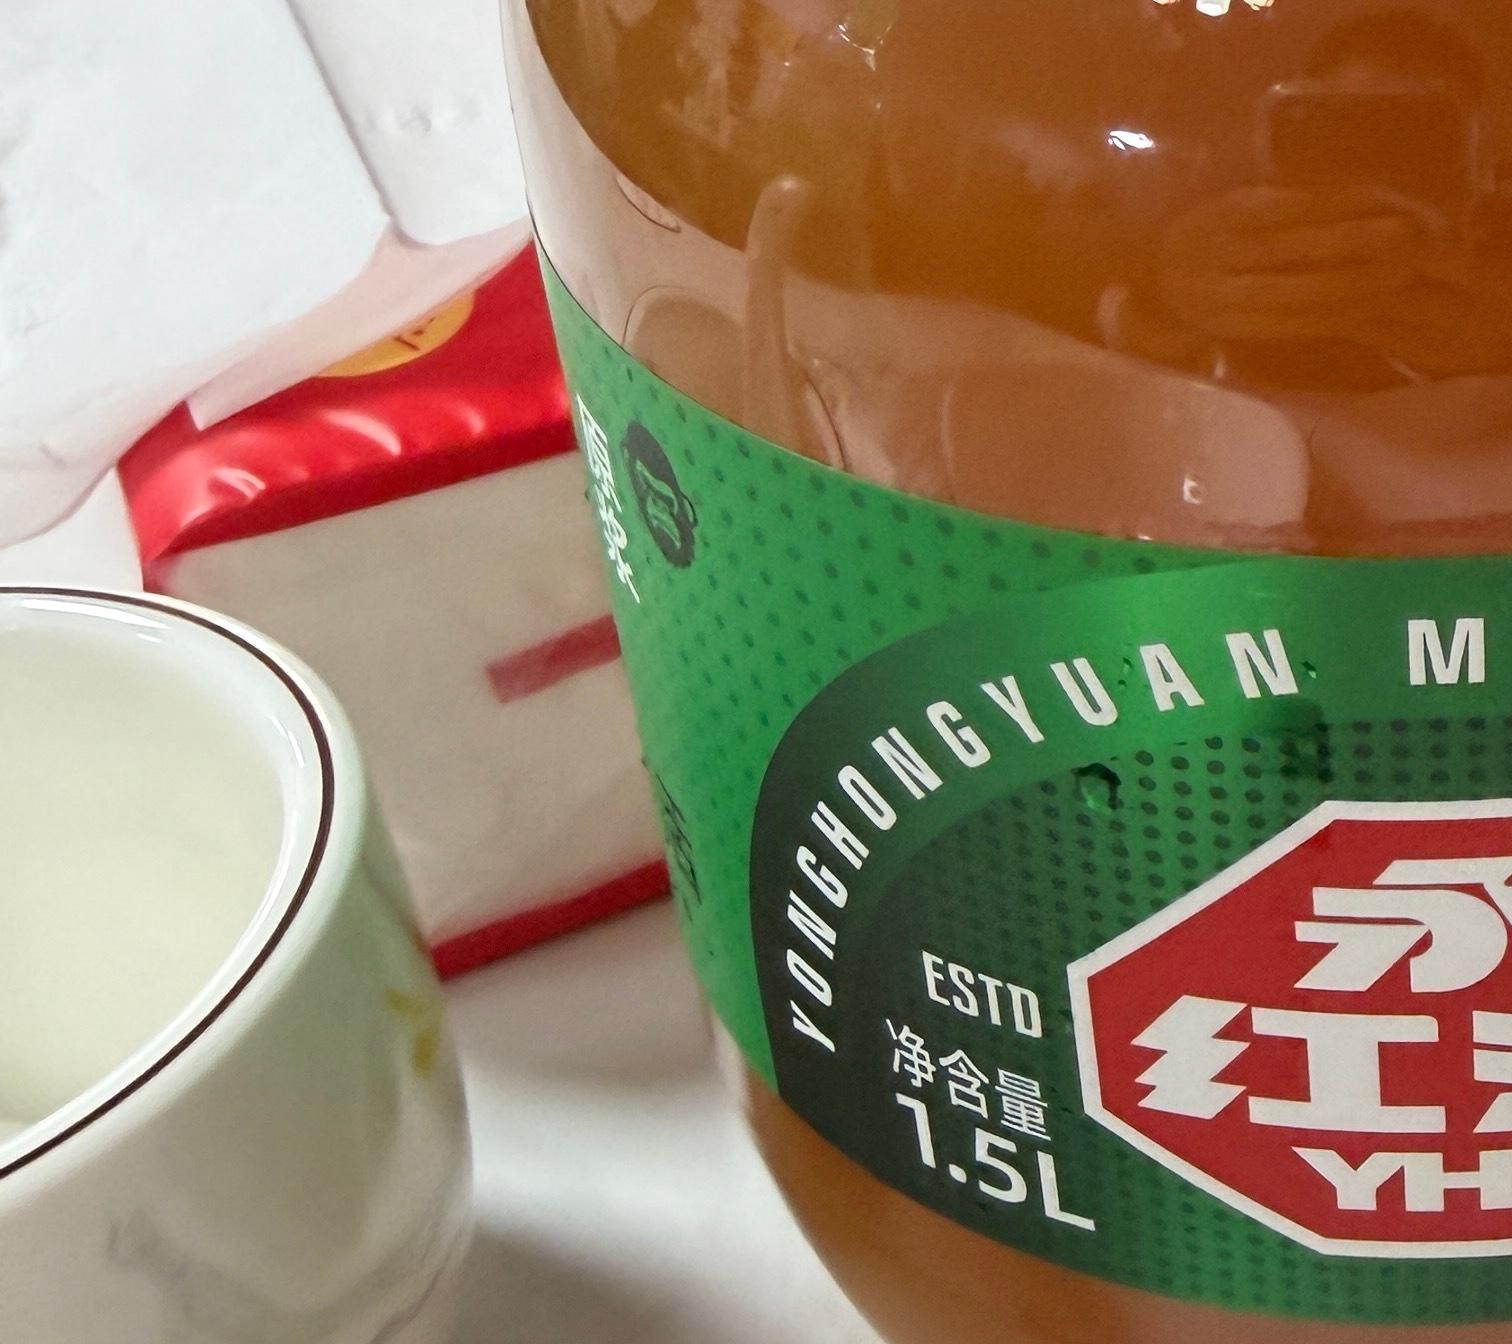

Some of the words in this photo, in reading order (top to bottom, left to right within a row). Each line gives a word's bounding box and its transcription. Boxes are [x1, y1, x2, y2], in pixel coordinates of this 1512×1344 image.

[787, 629, 1299, 1053] YONGHONGYUAN
[922, 950, 1042, 1038] ESTD
[886, 1019, 1051, 1141] 净含量
[896, 1093, 1096, 1231] 1.5L
